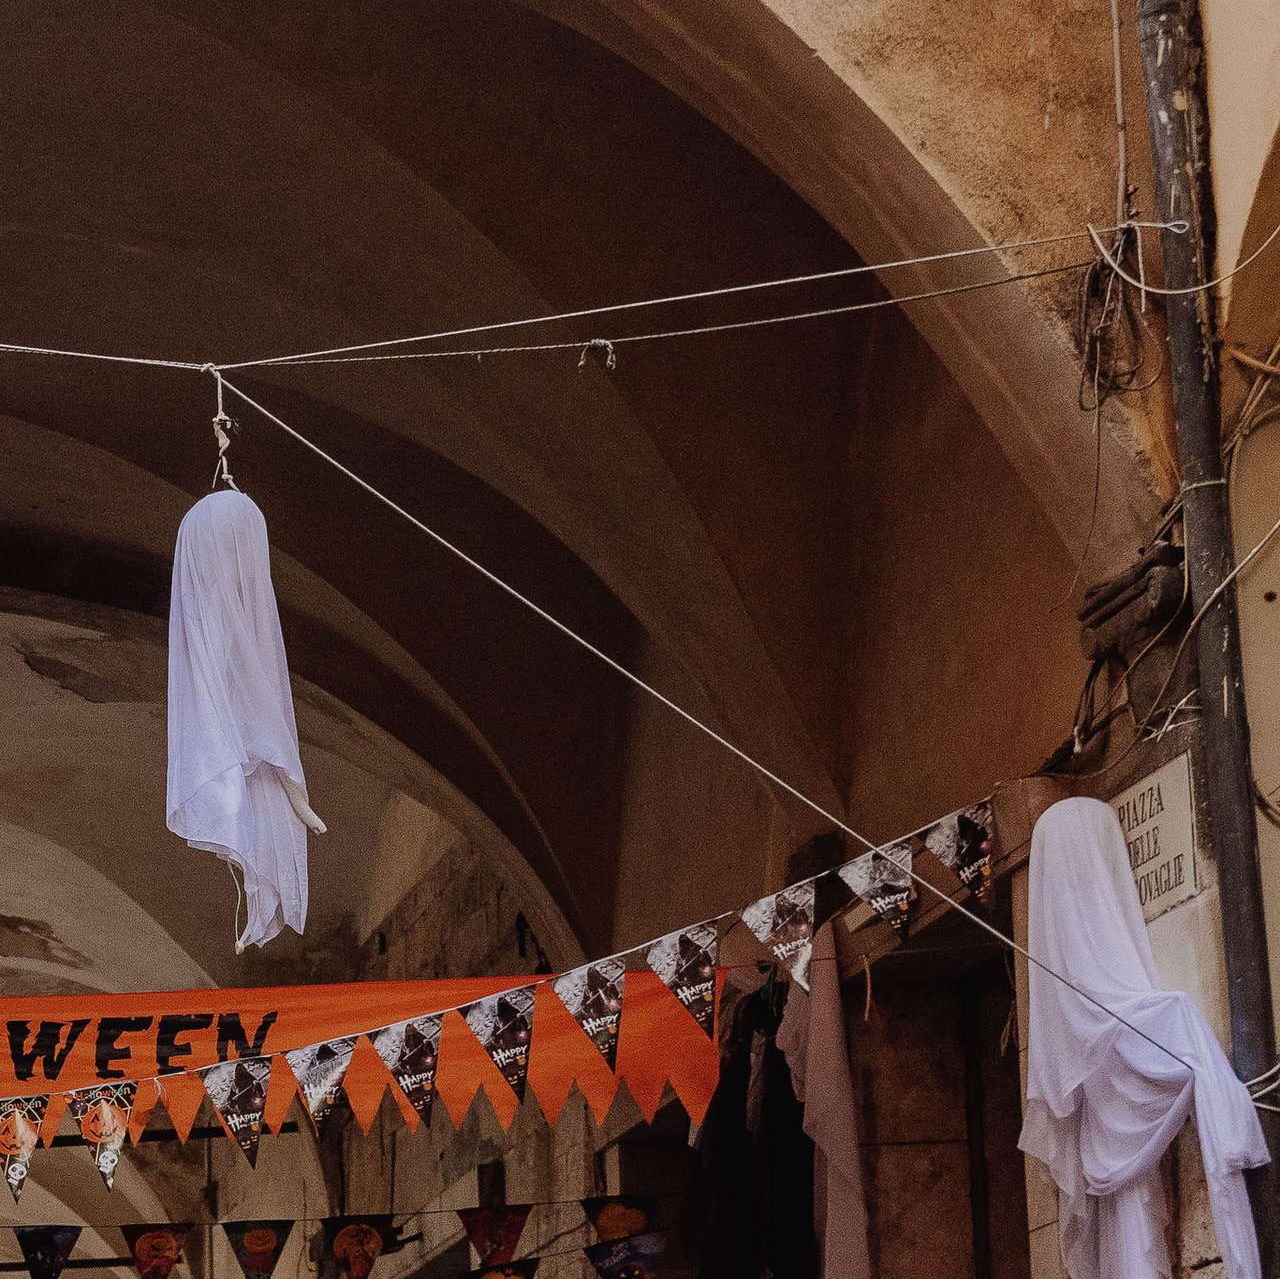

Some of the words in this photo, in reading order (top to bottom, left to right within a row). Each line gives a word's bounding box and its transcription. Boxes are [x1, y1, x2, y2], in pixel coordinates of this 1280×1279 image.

[1118, 783, 1165, 832] PIAZZA
[1128, 826, 1161, 870] DELLE
[1135, 853, 1185, 906] OVAGLIE
[871, 890, 910, 913] HAPPY
[772, 936, 810, 960] HAPPY
[677, 980, 713, 1006] HAPPY
[582, 1013, 619, 1037] HAPPY
[492, 1044, 528, 1068] HAPPY
[399, 1070, 434, 1094] HAPPY
[227, 1111, 262, 1132] HAPPY
